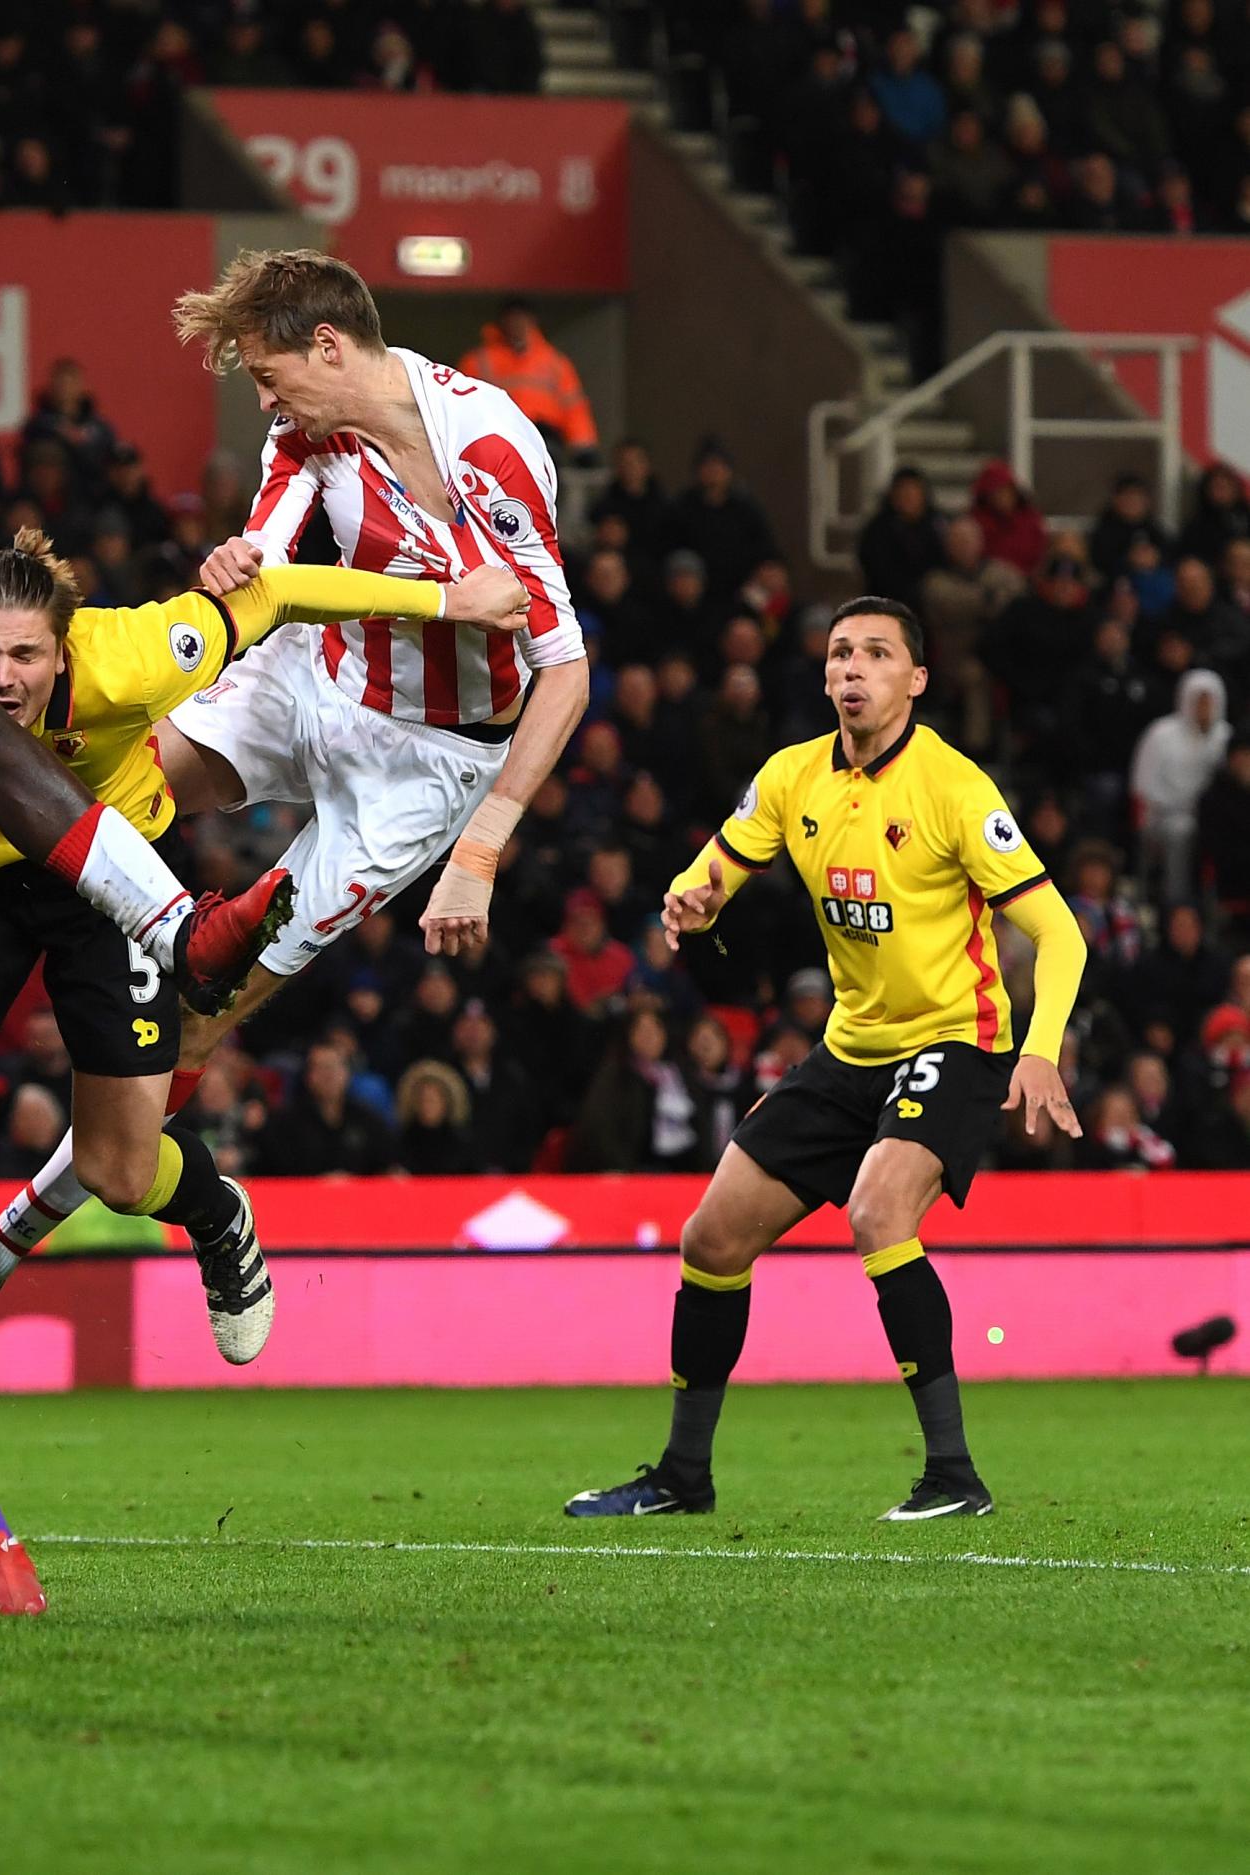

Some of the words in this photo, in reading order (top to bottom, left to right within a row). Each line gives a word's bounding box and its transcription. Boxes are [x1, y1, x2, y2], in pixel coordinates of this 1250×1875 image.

[825, 900, 890, 931] 138
[840, 928, 880, 948] .com
[127, 934, 161, 1004] 5
